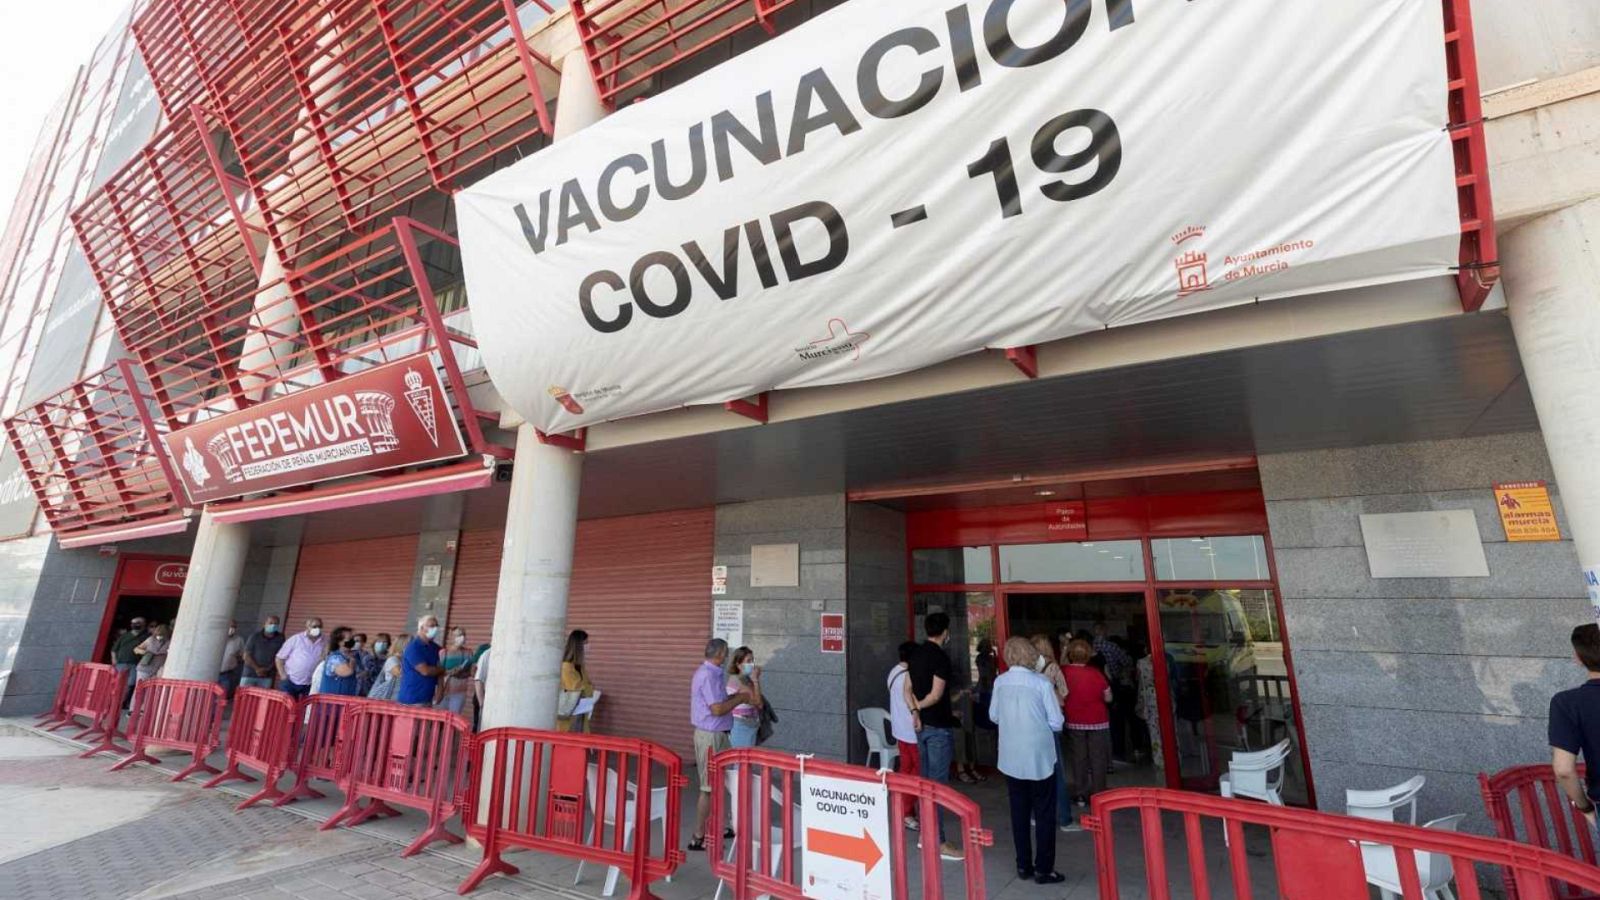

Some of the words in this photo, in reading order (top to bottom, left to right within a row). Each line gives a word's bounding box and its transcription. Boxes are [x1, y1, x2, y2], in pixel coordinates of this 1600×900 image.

[513, 0, 1136, 254] VACUNACIO
[578, 200, 849, 333] COVID
[890, 203, 928, 230] -
[967, 108, 1122, 219] 19
[1223, 240, 1313, 266] Ayuntamiento
[1225, 270, 1240, 281] de
[1243, 260, 1289, 277] Murcia
[225, 394, 365, 463] FEPEMUR
[243, 461, 282, 477] FEDERACIÓN
[282, 459, 292, 470] DE
[292, 453, 315, 468] PEÑAS
[316, 441, 371, 463] MURCIANISTAS
[1503, 511, 1552, 519] alarmas
[1508, 518, 1550, 526] murcia
[809, 786, 876, 806] VACUNACIÓN
[816, 802, 848, 815] COVID
[857, 809, 869, 819] 19
